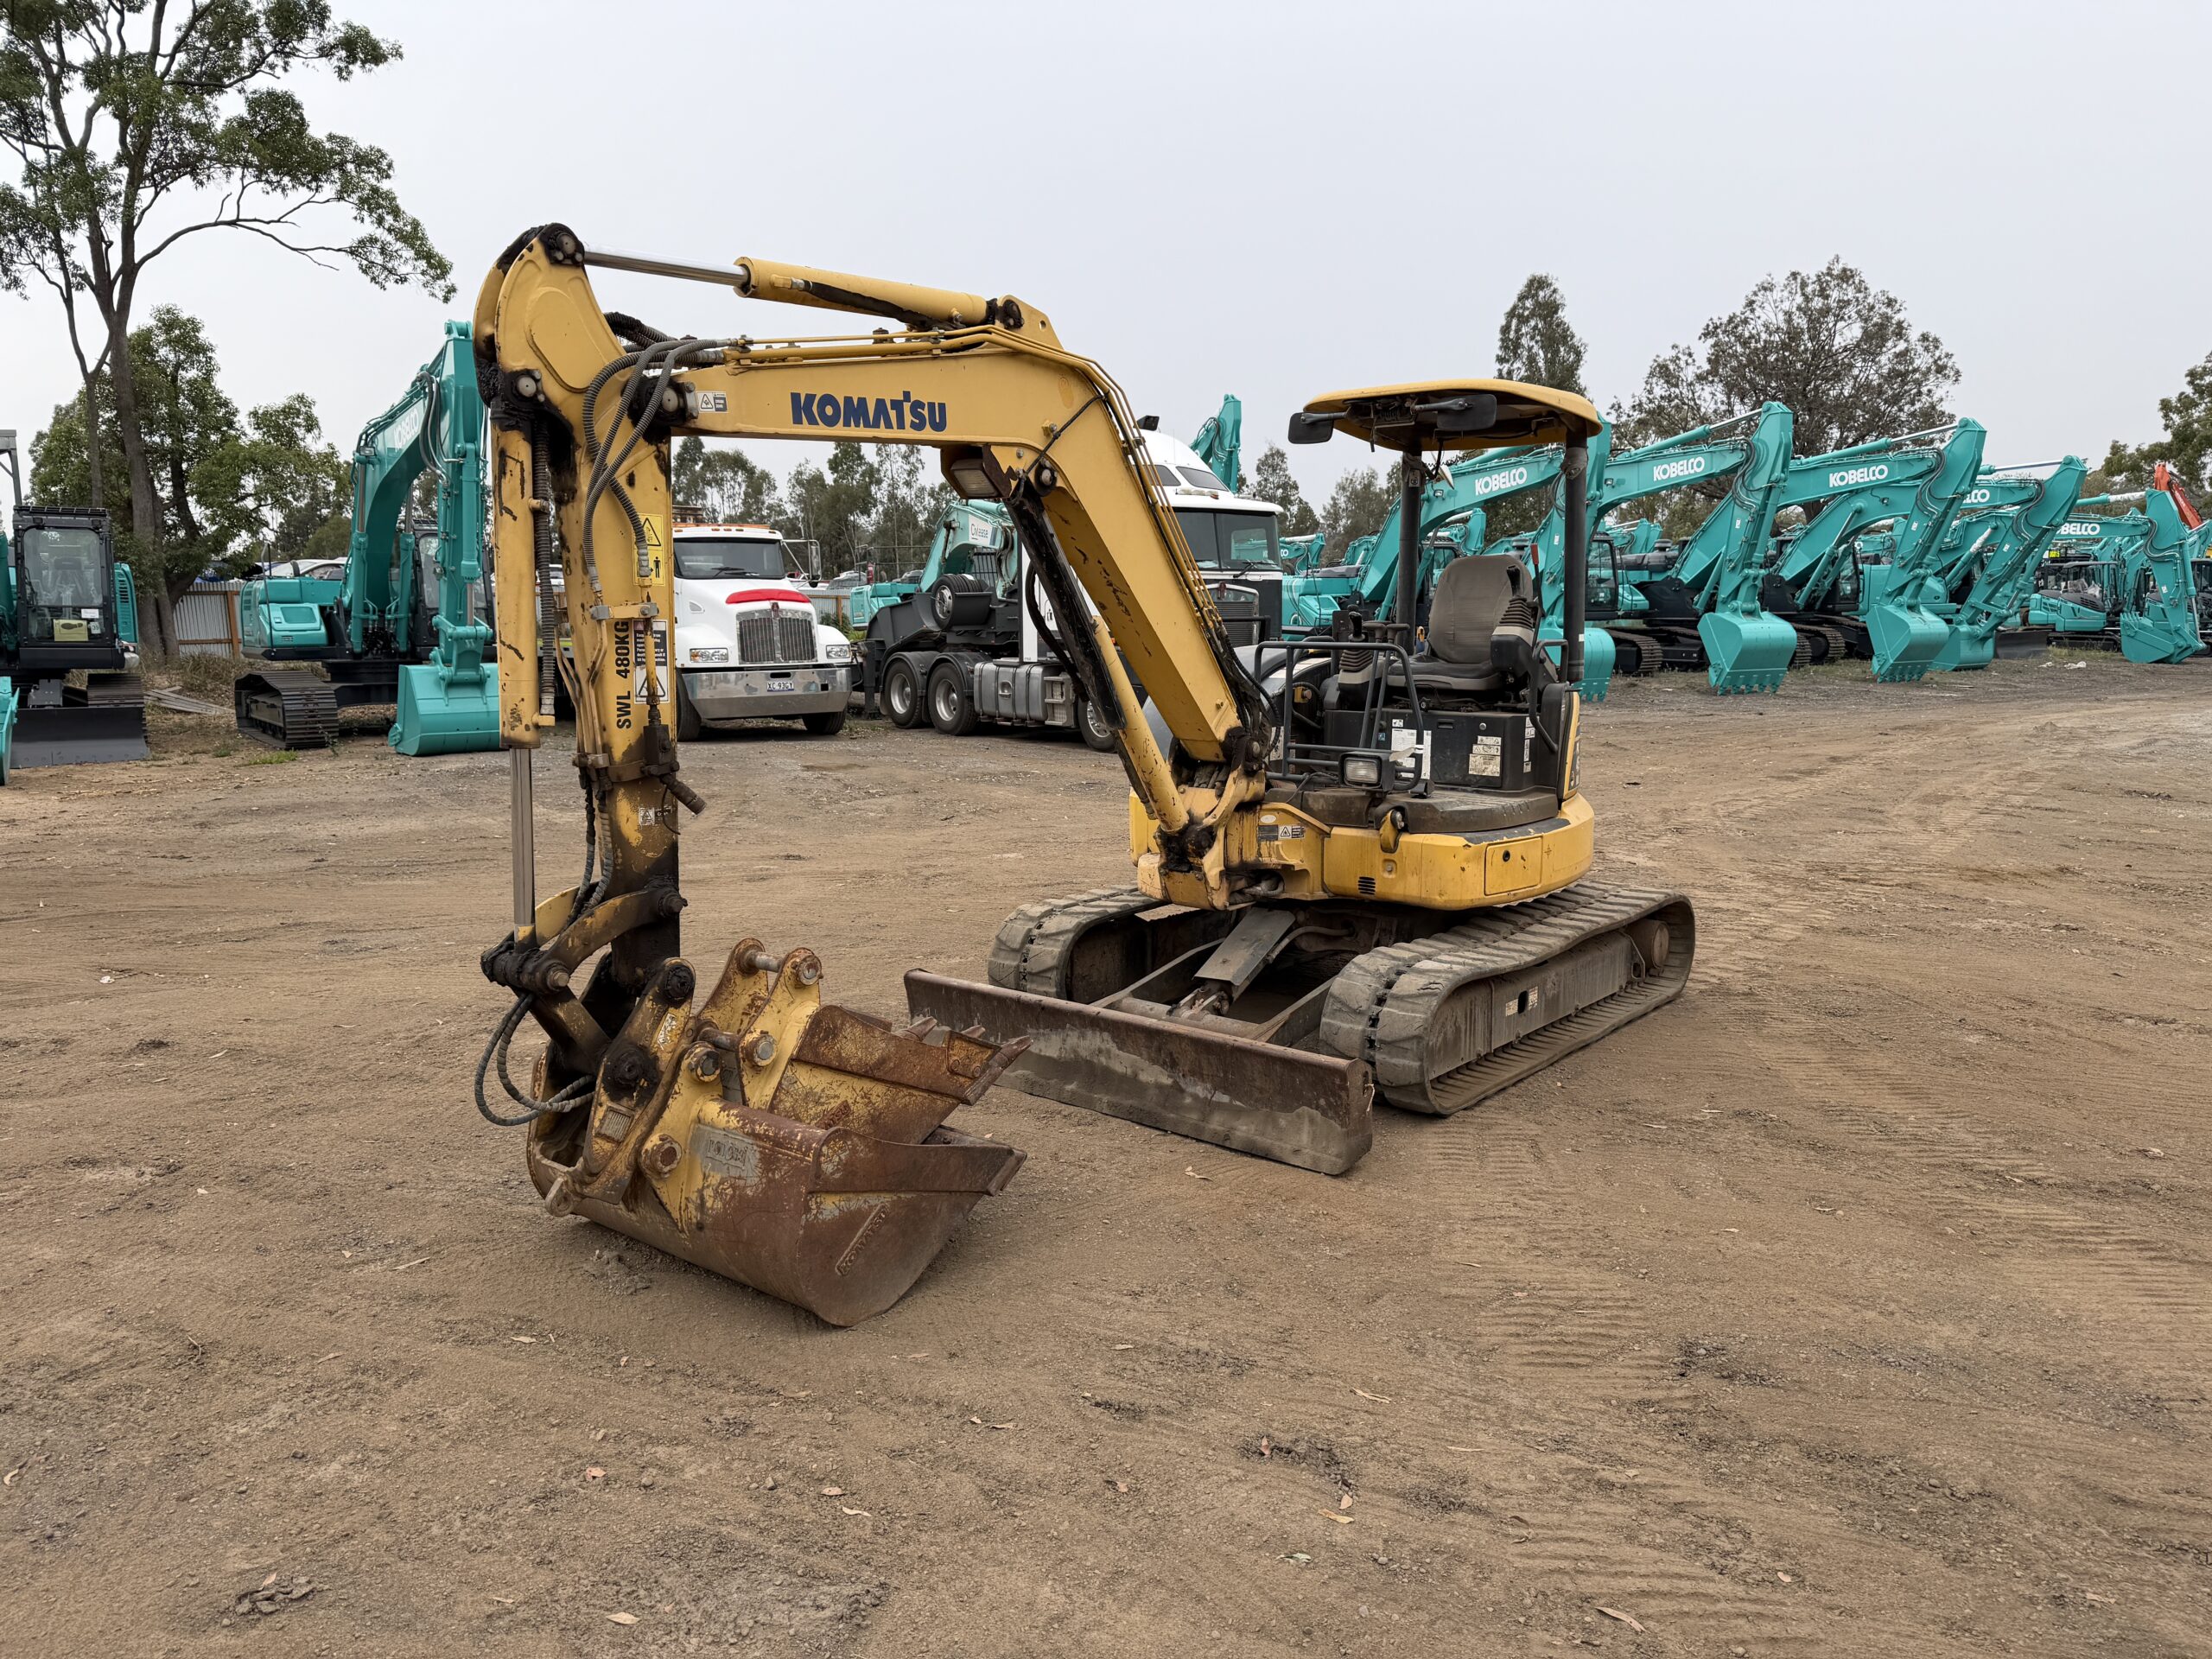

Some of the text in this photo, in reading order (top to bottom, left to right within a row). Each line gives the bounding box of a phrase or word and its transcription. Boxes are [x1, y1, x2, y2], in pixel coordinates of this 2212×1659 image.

[790, 391, 947, 432] KOMATSU
[394, 407, 419, 453] KOBELCO
[1475, 467, 1528, 496] KOBELCO
[1653, 456, 1705, 482] KOBELCO
[1829, 465, 1888, 487] KOBELCO
[2056, 523, 2101, 536] BELCO
[613, 620, 632, 729] SWL 480KG
